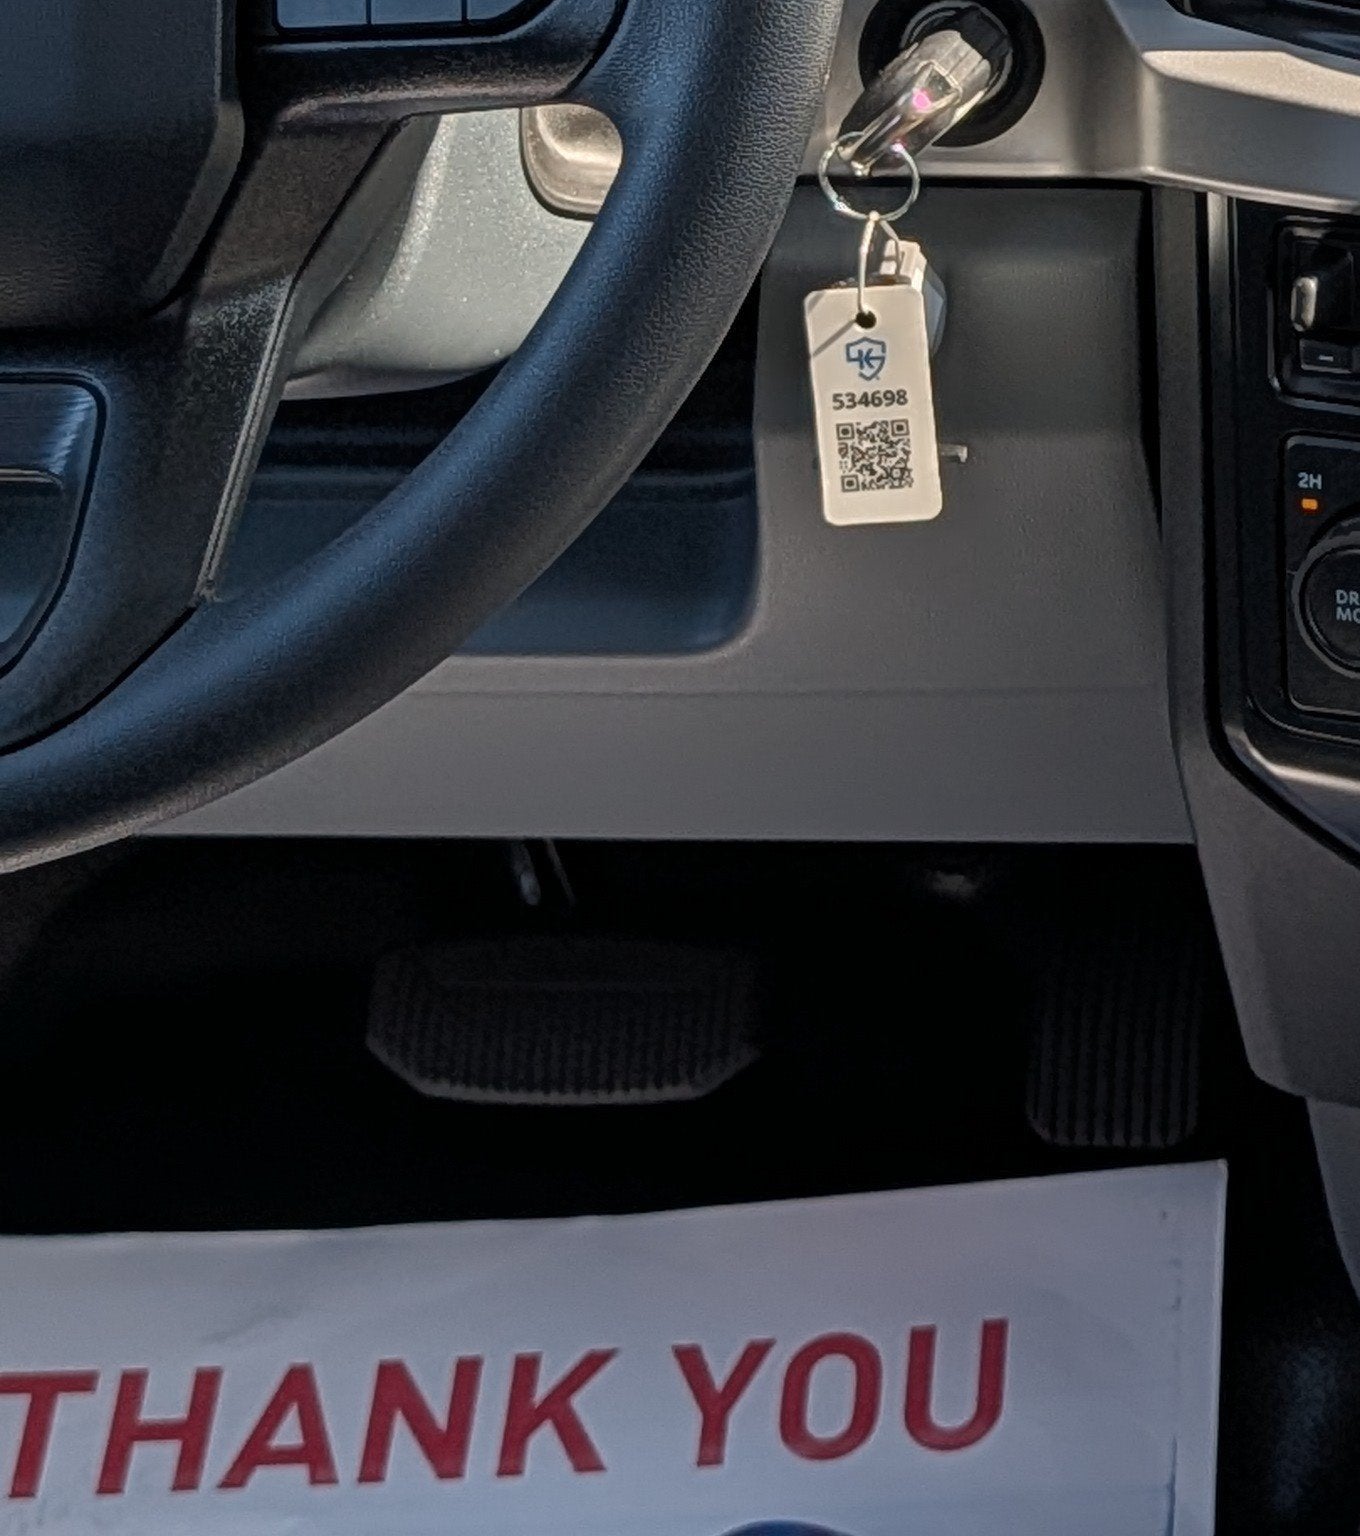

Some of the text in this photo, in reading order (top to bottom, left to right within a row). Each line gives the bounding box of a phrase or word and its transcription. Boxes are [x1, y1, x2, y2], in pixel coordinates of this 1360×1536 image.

[832, 388, 908, 411] 534698
[1298, 472, 1322, 490] 2H
[0, 1318, 1010, 1500] THANK YOU
